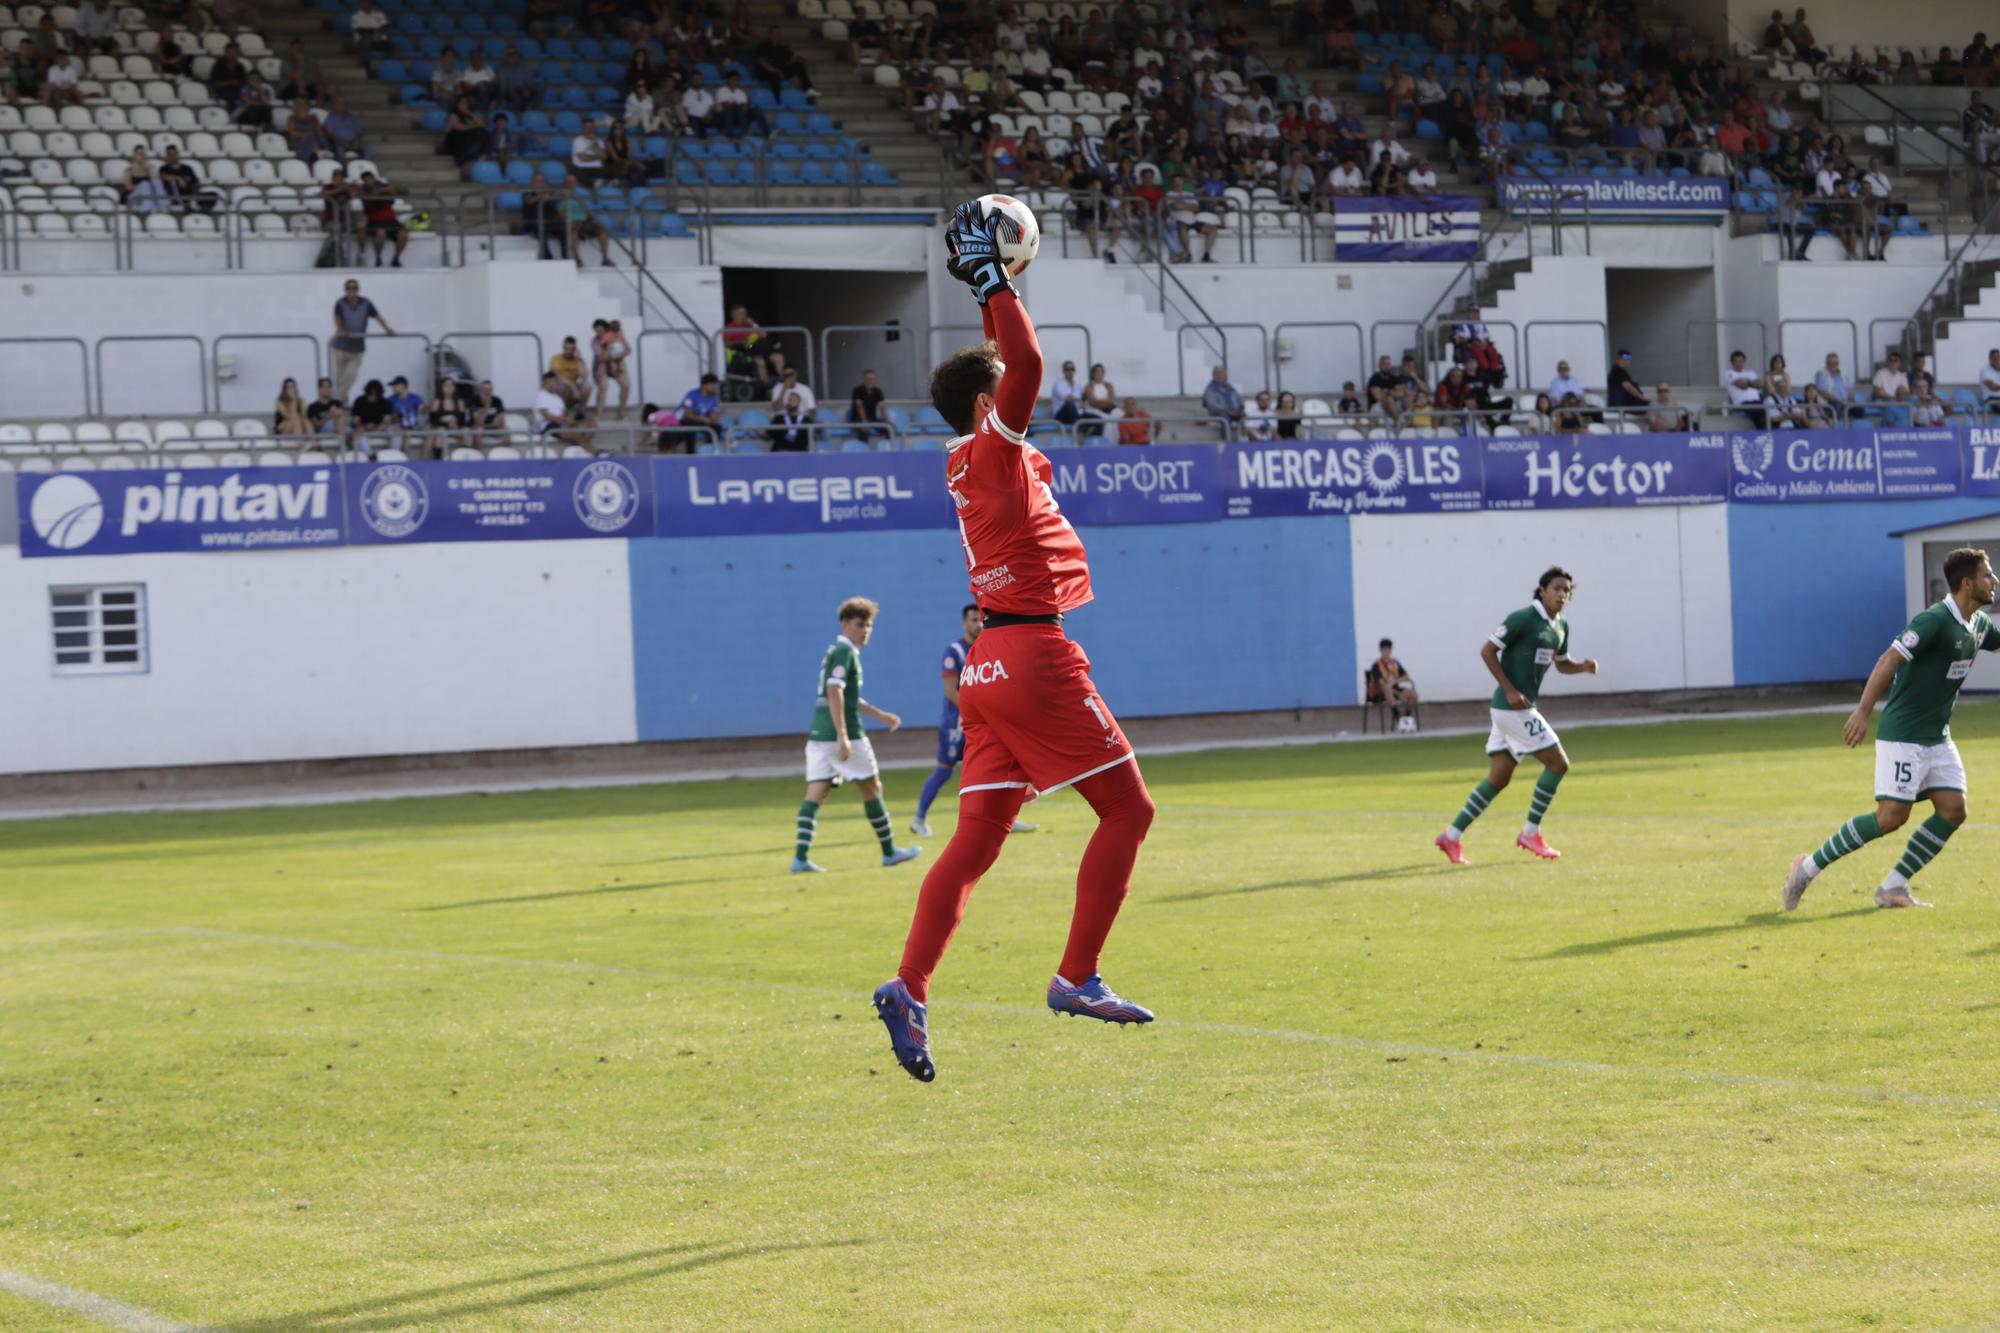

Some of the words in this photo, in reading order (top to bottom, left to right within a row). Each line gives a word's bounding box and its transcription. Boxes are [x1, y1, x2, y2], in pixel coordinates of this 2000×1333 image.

[1488, 441, 1540, 451] AUTOCARES
[1689, 436, 1724, 448] AVILÉS
[1238, 442, 1461, 493] MERCASOLES
[1786, 440, 1873, 472] Gema
[485, 477, 525, 488] PRADO
[1096, 455, 1194, 499] SPORT
[1525, 450, 1673, 497] Héctor
[688, 466, 914, 524] LATERAL
[1308, 491, 1343, 510] Frutas
[1735, 481, 1776, 498] Gestión
[1779, 483, 1786, 501] y
[1789, 480, 1822, 495] Medio
[1826, 478, 1876, 494] Ambiente
[121, 470, 330, 536] pintavi
[831, 502, 859, 521] sport
[861, 501, 886, 518] club
[201, 528, 339, 547] www.pintavi.com
[959, 659, 1009, 686] ANCA
[1523, 718, 1547, 737] 22
[1894, 760, 1912, 783] 15
